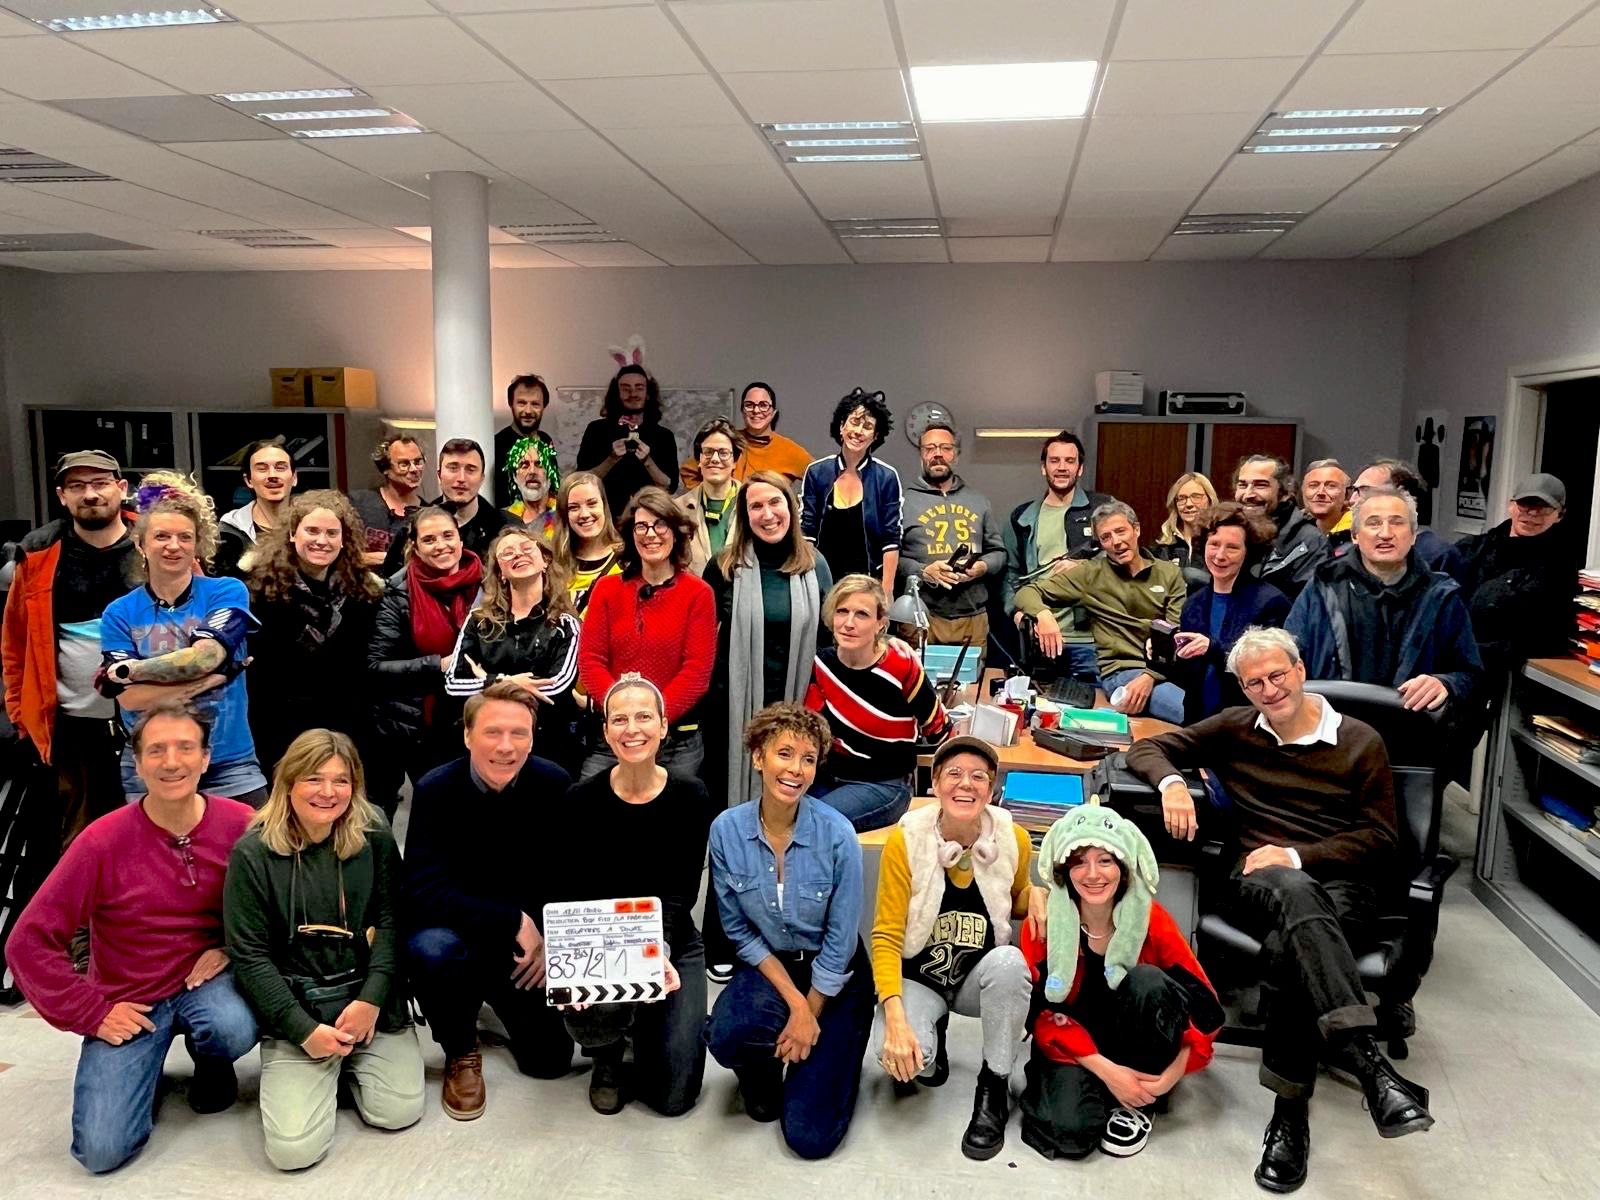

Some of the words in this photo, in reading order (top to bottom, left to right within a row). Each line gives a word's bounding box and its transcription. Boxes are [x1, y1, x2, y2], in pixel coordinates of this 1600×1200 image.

[918, 503, 946, 525] NEW
[950, 503, 979, 523] YORK
[934, 519, 970, 542] 75
